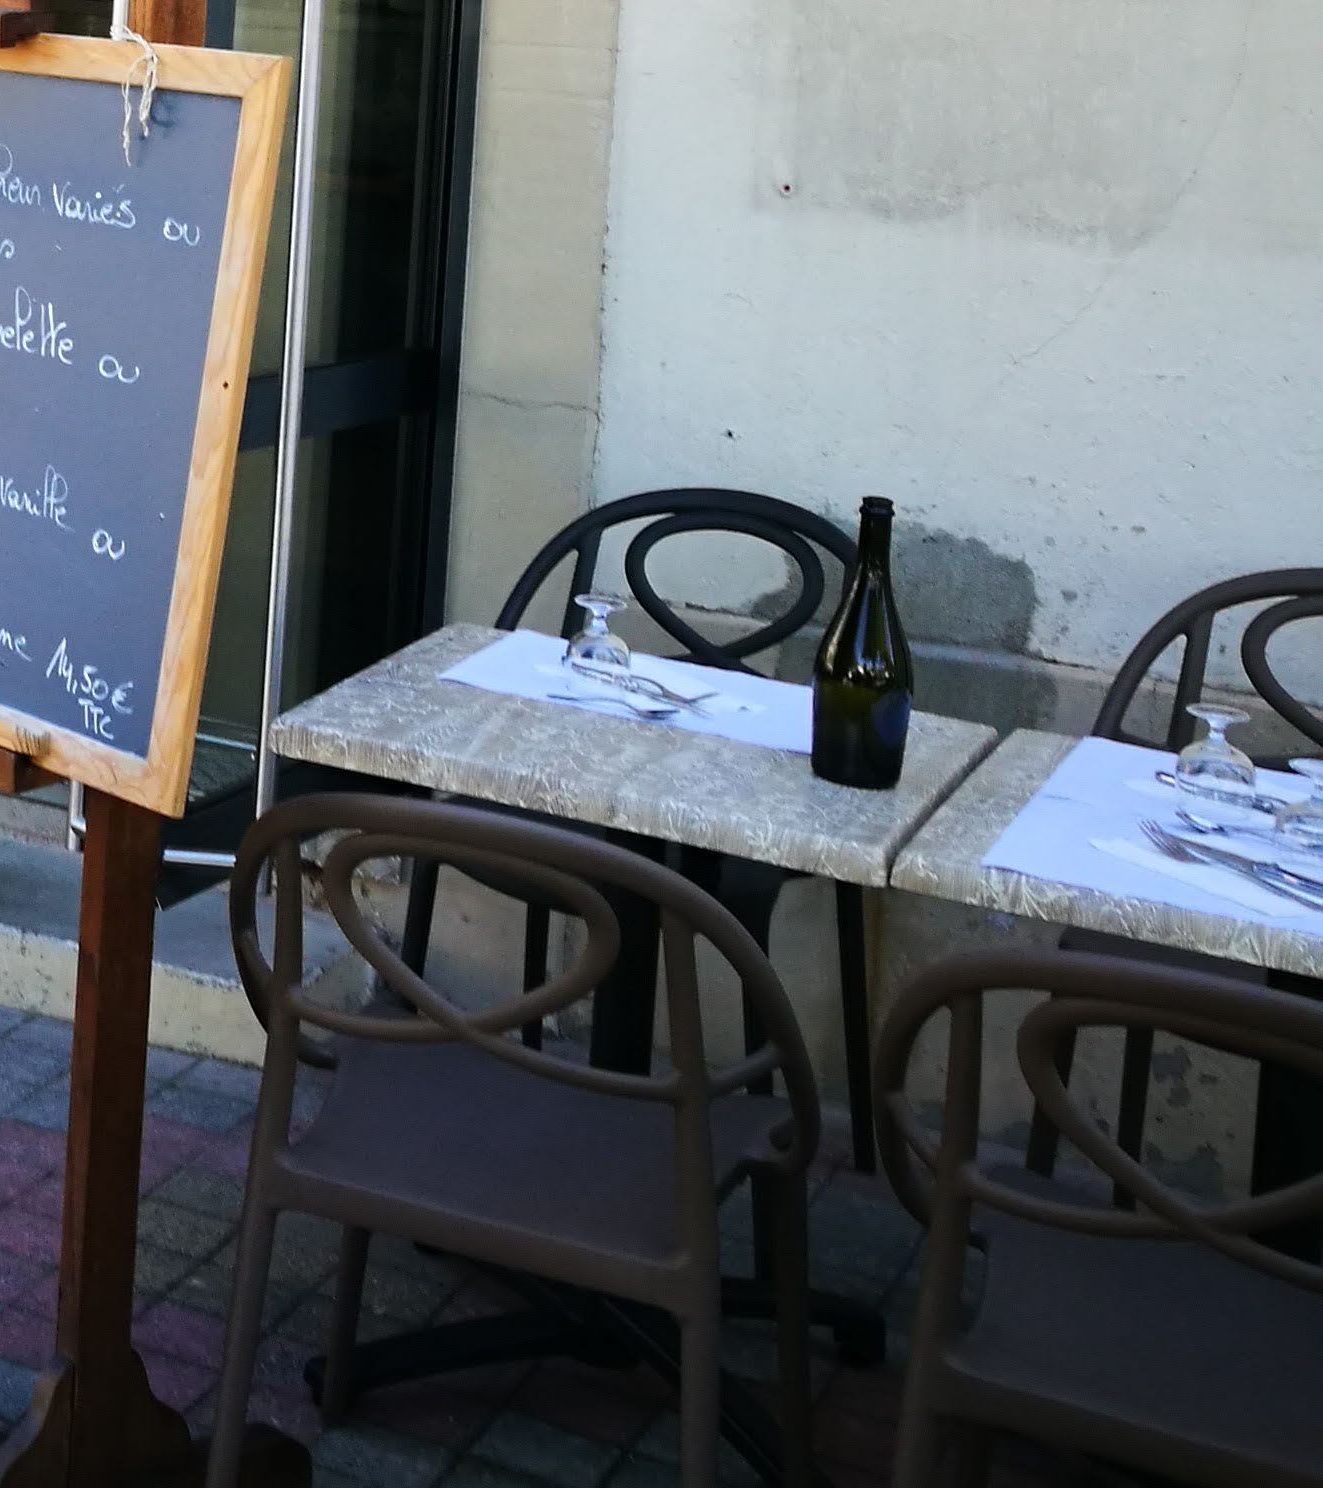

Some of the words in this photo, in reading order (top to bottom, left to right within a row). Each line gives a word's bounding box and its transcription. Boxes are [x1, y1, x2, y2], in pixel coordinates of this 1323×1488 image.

[162, 216, 201, 247] ou
[98, 353, 141, 385] ou
[92, 528, 126, 560] ou
[78, 698, 115, 741] TTC
